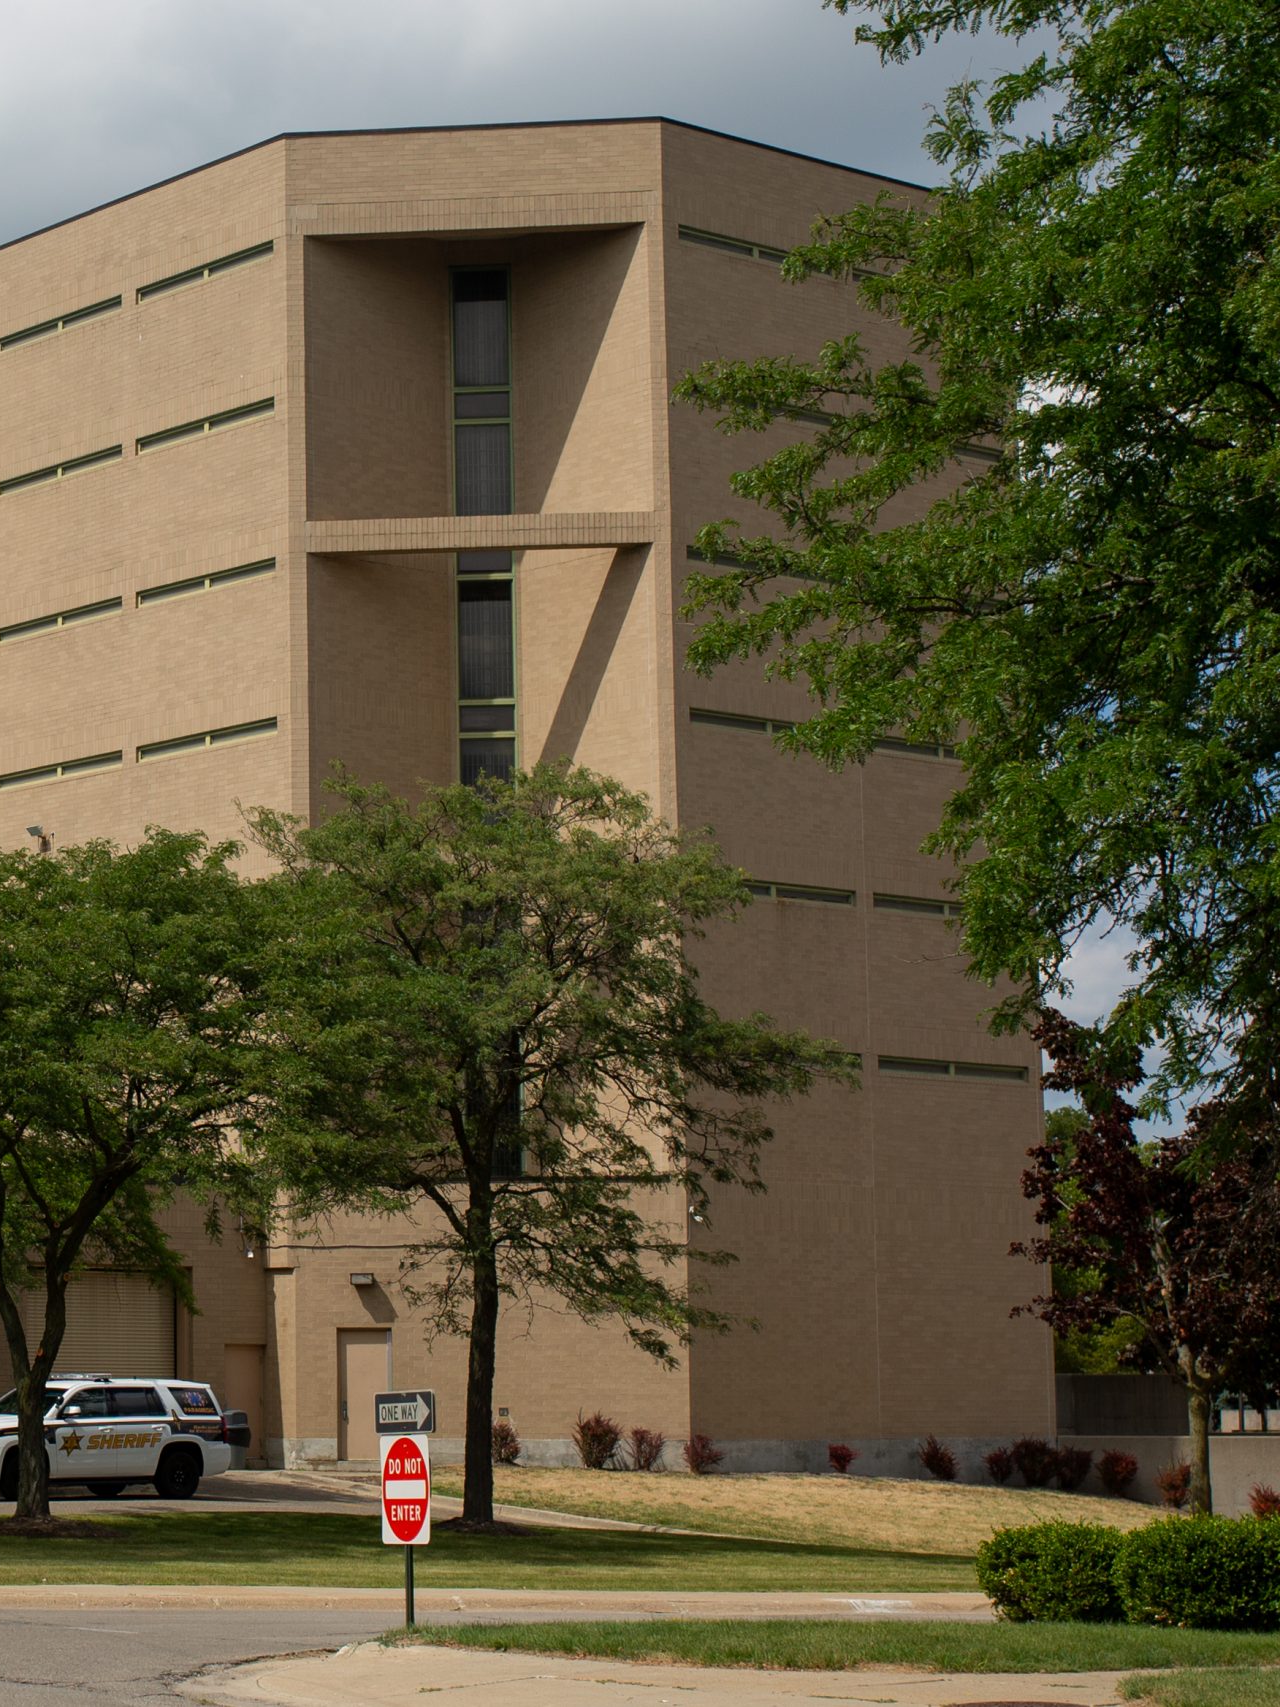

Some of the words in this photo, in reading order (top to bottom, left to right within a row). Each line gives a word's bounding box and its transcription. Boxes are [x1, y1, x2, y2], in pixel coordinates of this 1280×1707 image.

[381, 1405, 399, 1421] ONE
[401, 1404, 418, 1420] WAY
[86, 1433, 162, 1449] SHERIFF
[389, 1458, 401, 1475] DO
[404, 1458, 422, 1474] NOT
[391, 1505, 421, 1521] ENTER
